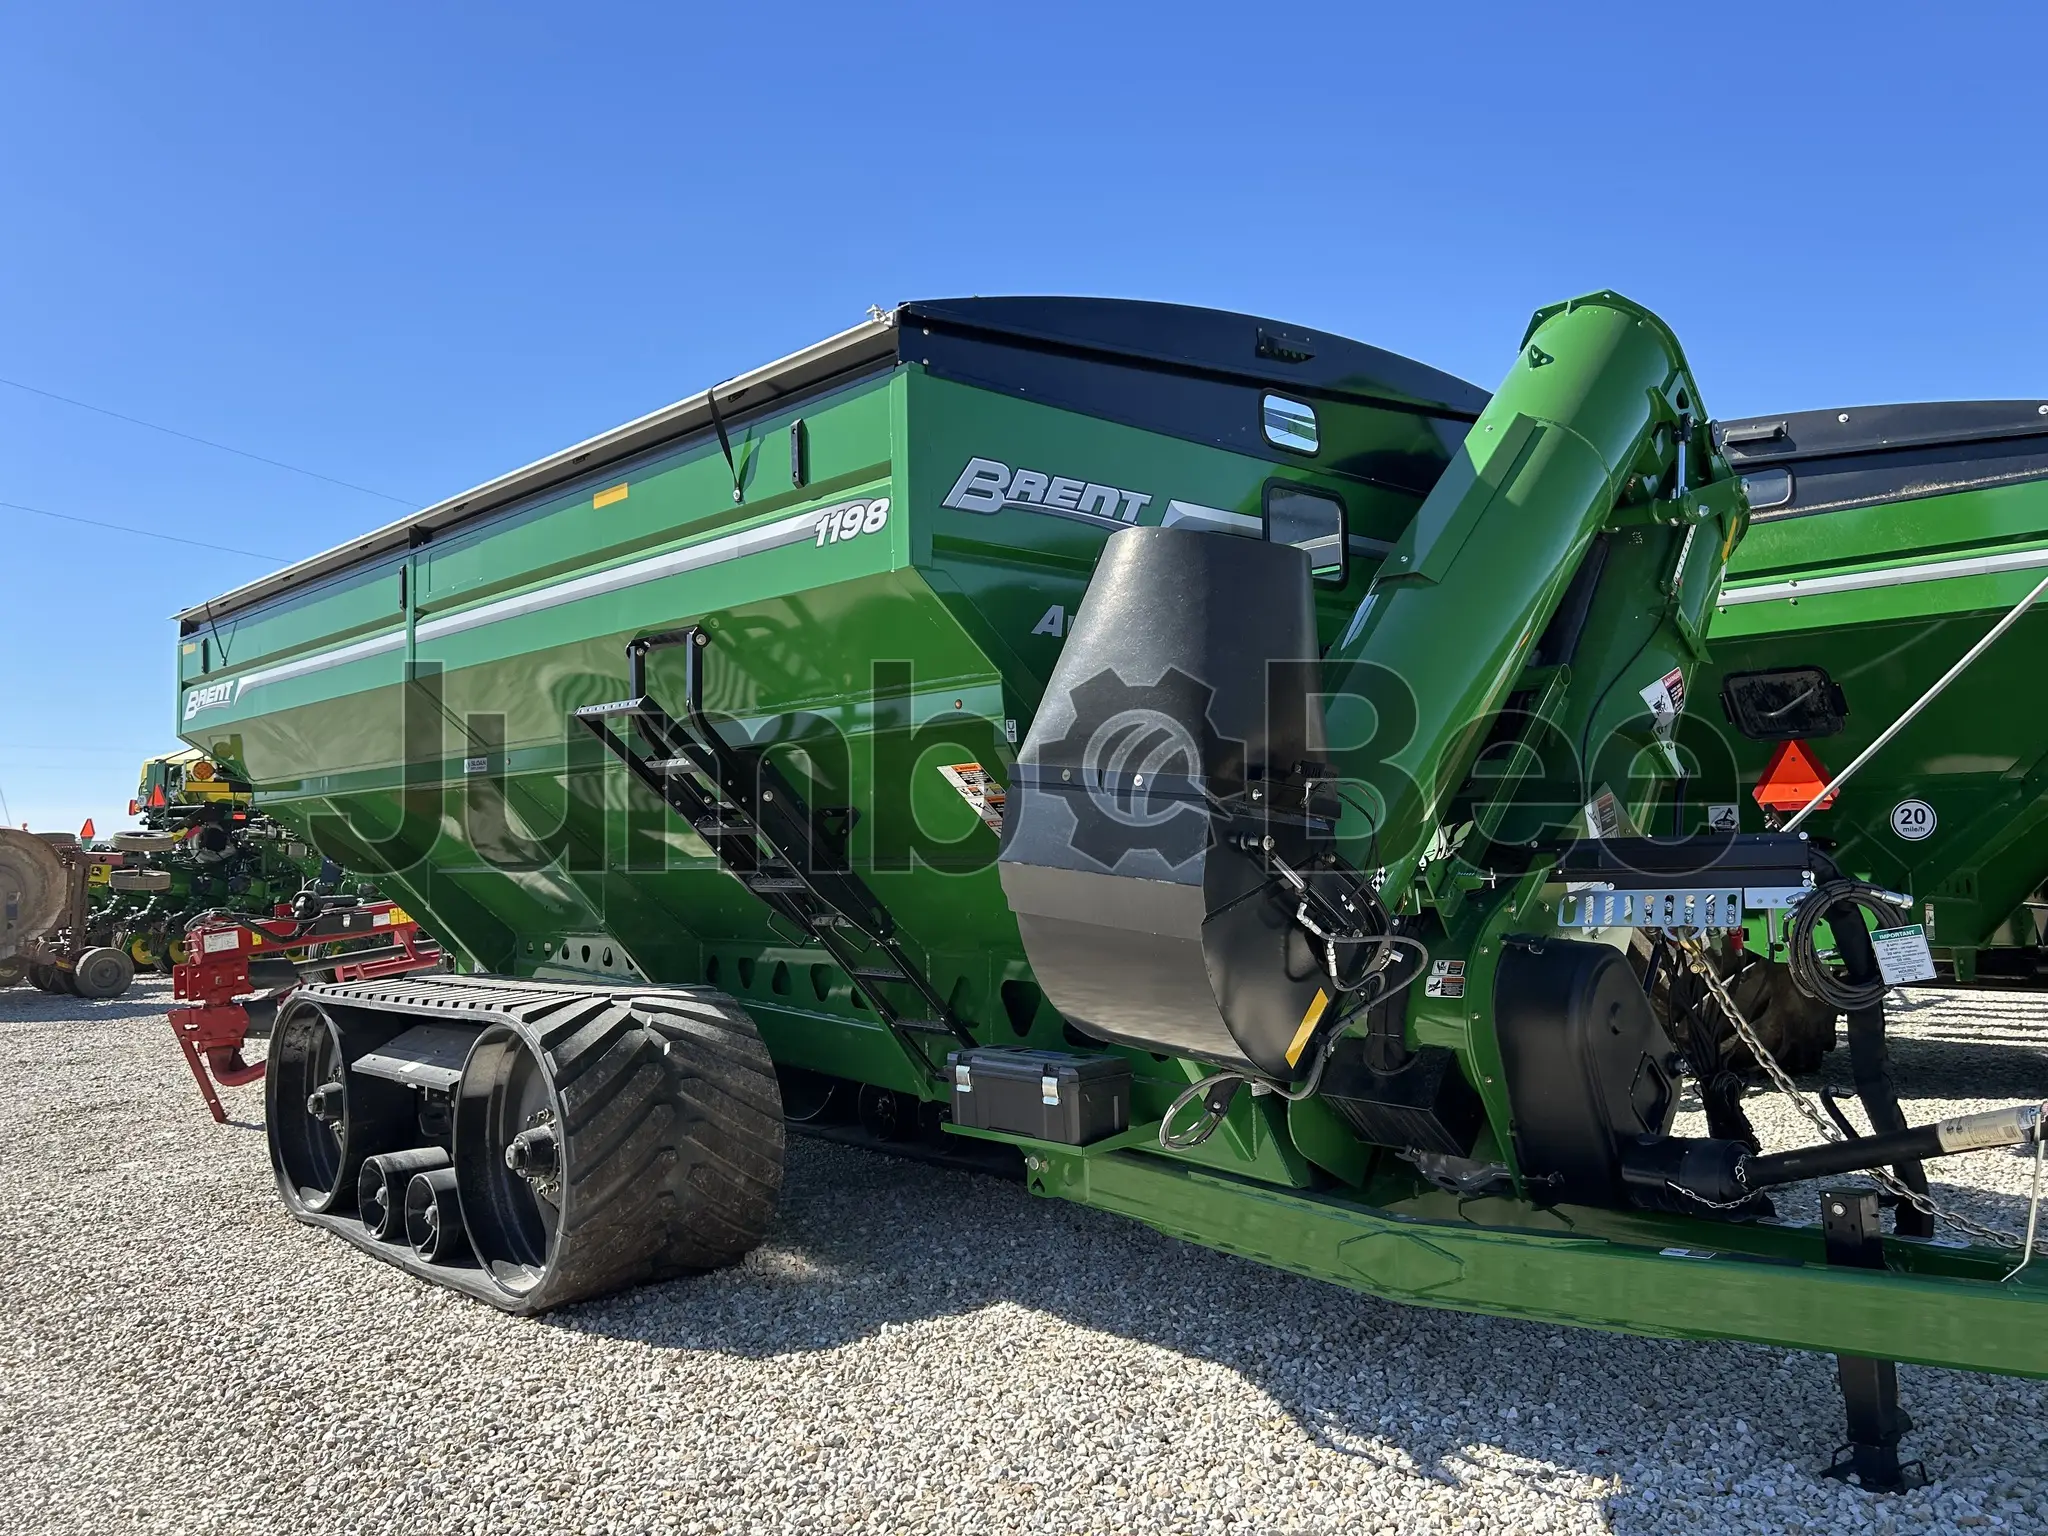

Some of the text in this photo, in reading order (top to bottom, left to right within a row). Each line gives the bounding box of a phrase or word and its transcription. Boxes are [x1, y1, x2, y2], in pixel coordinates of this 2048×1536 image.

[939, 456, 1153, 525] BRENT
[814, 497, 891, 549] 1198
[183, 680, 235, 721] BRENT
[1900, 808, 1926, 825] 20
[1879, 929, 1915, 940] IMPORTANT
